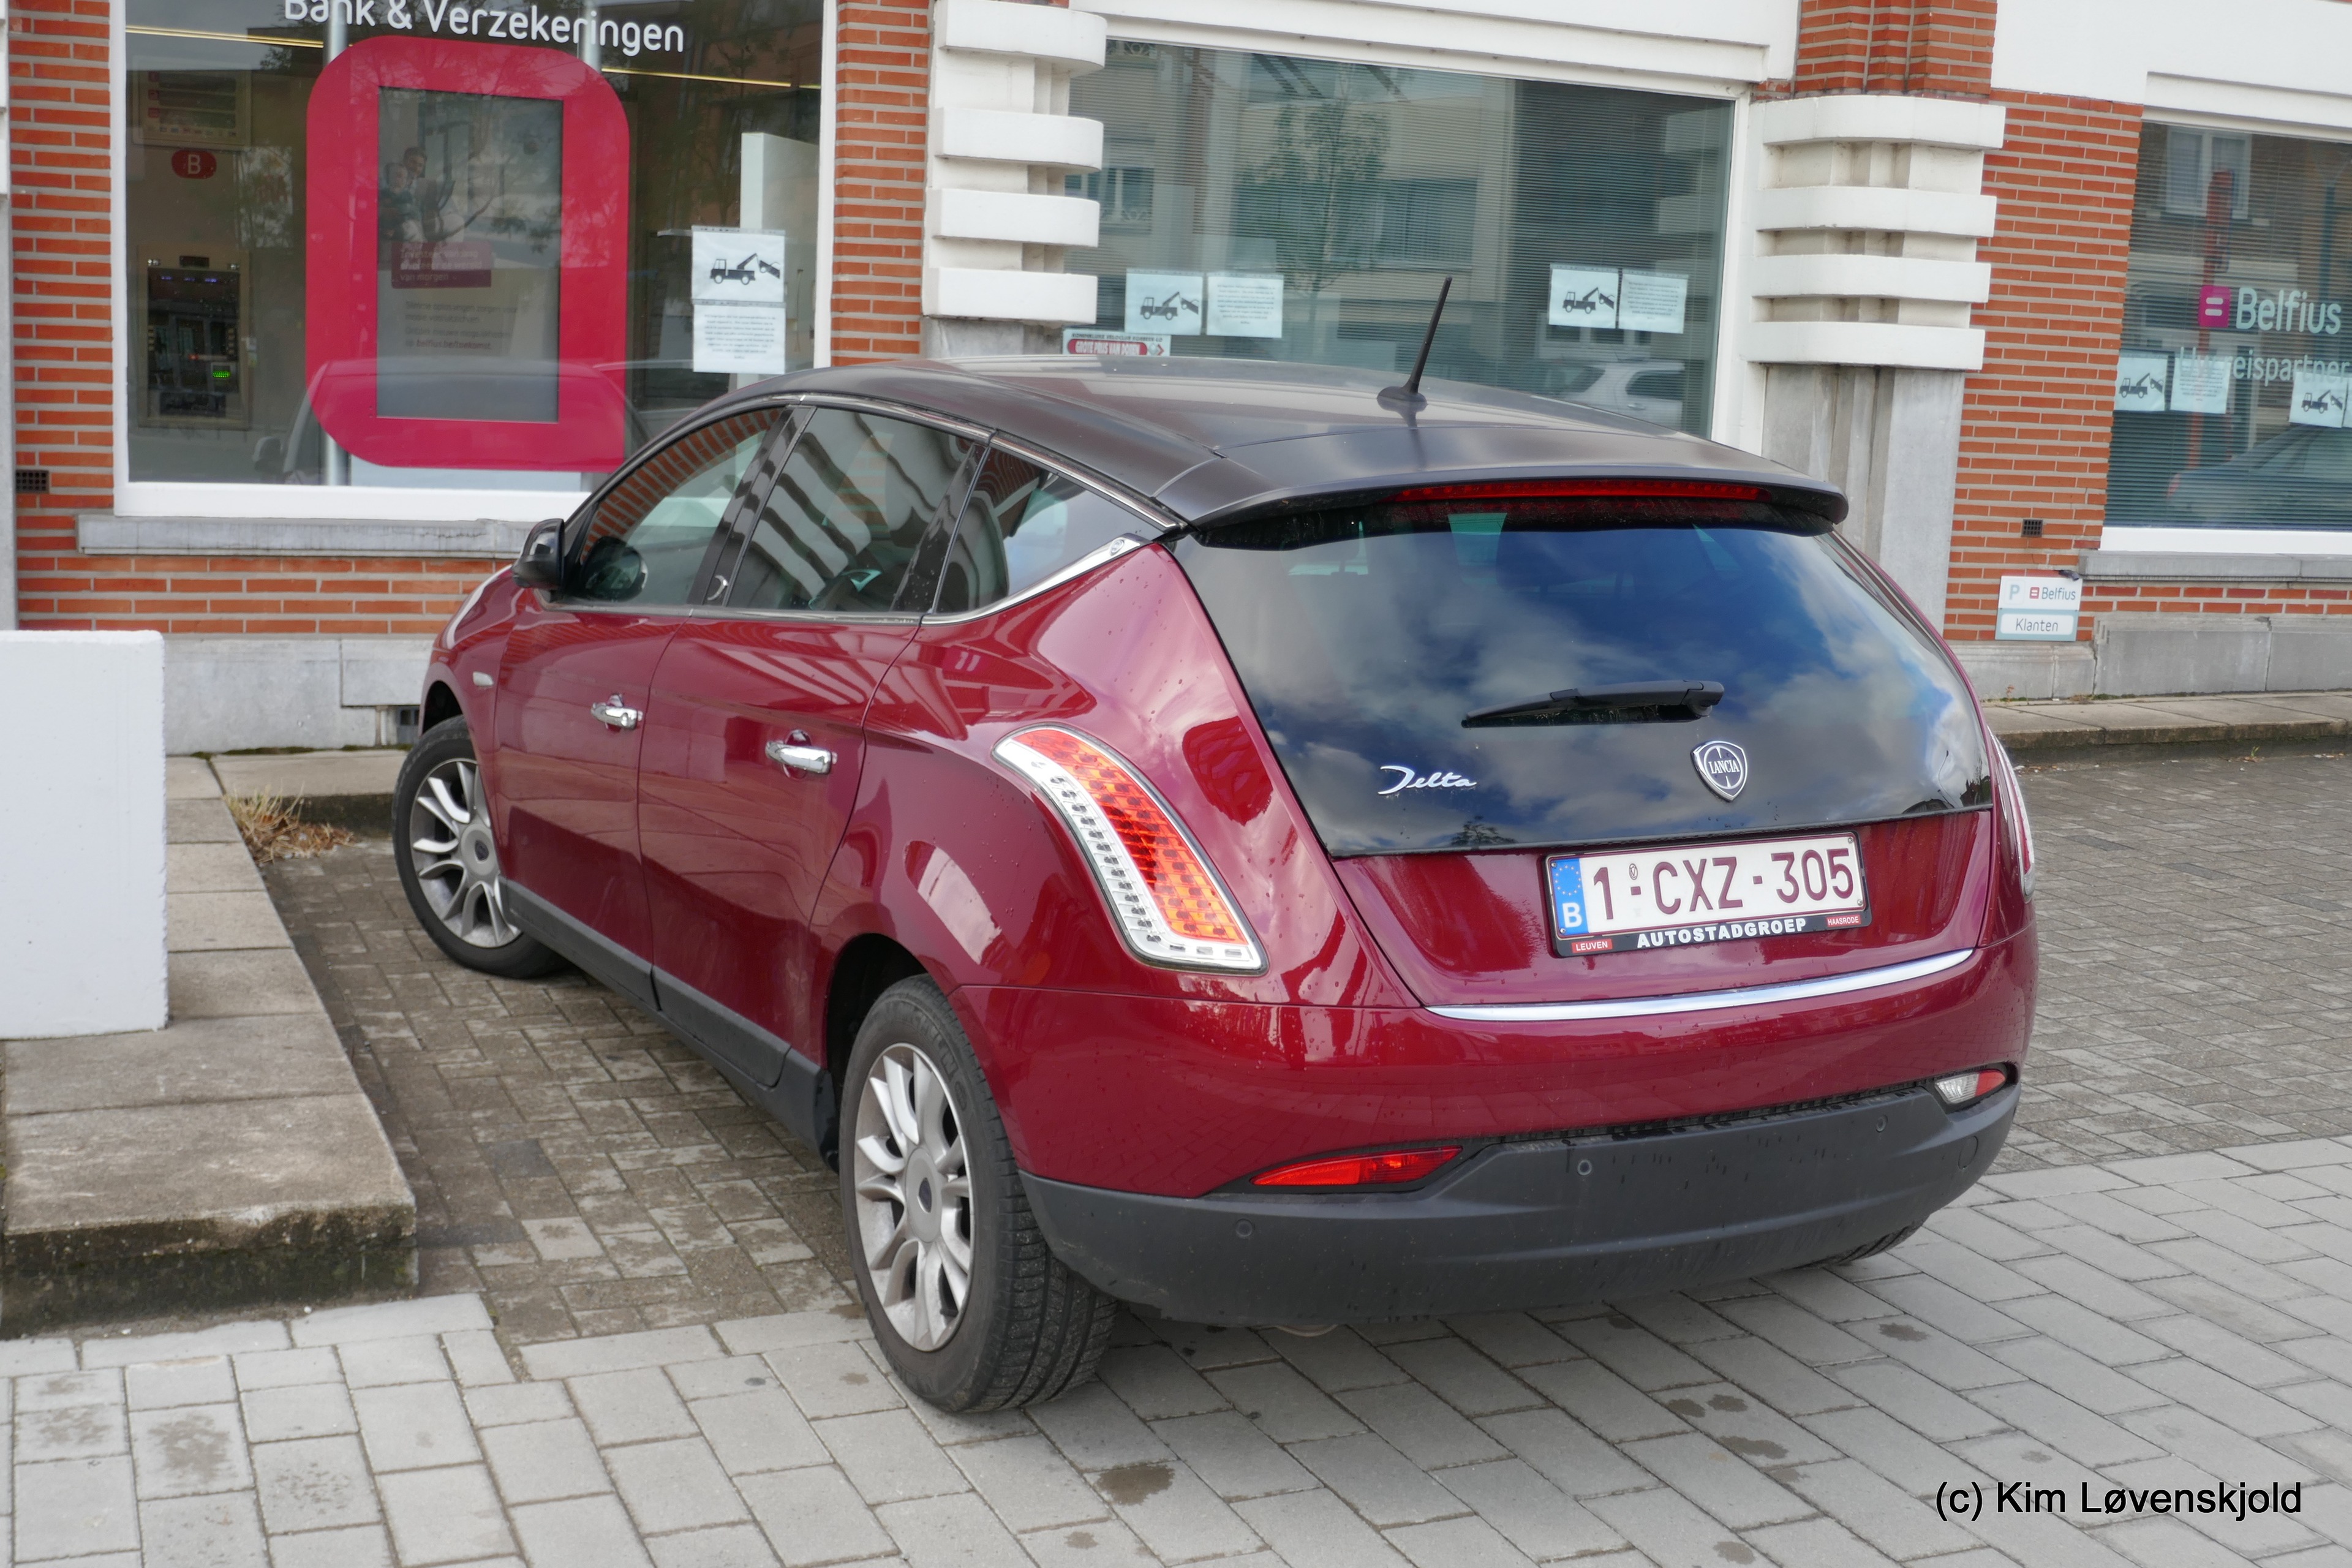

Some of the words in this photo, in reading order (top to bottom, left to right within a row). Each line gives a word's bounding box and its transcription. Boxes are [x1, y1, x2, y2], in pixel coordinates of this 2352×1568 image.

[285, 0, 375, 26] Bank
[387, 0, 413, 29] &
[423, 0, 684, 56] Verzekeringen
[187, 154, 201, 175] B
[2236, 287, 2342, 334] Belfius
[2009, 584, 2020, 600] P
[2041, 587, 2076, 600] Belfius
[2015, 618, 2059, 631] Klanten
[1378, 765, 1477, 794] Delta
[1708, 760, 1740, 774] LANCIA
[1562, 902, 1583, 928] B
[1575, 941, 1608, 951] LEUVEN
[1637, 918, 1806, 948] AUTOSTADGROEP
[1827, 916, 1859, 925] HAASRODE
